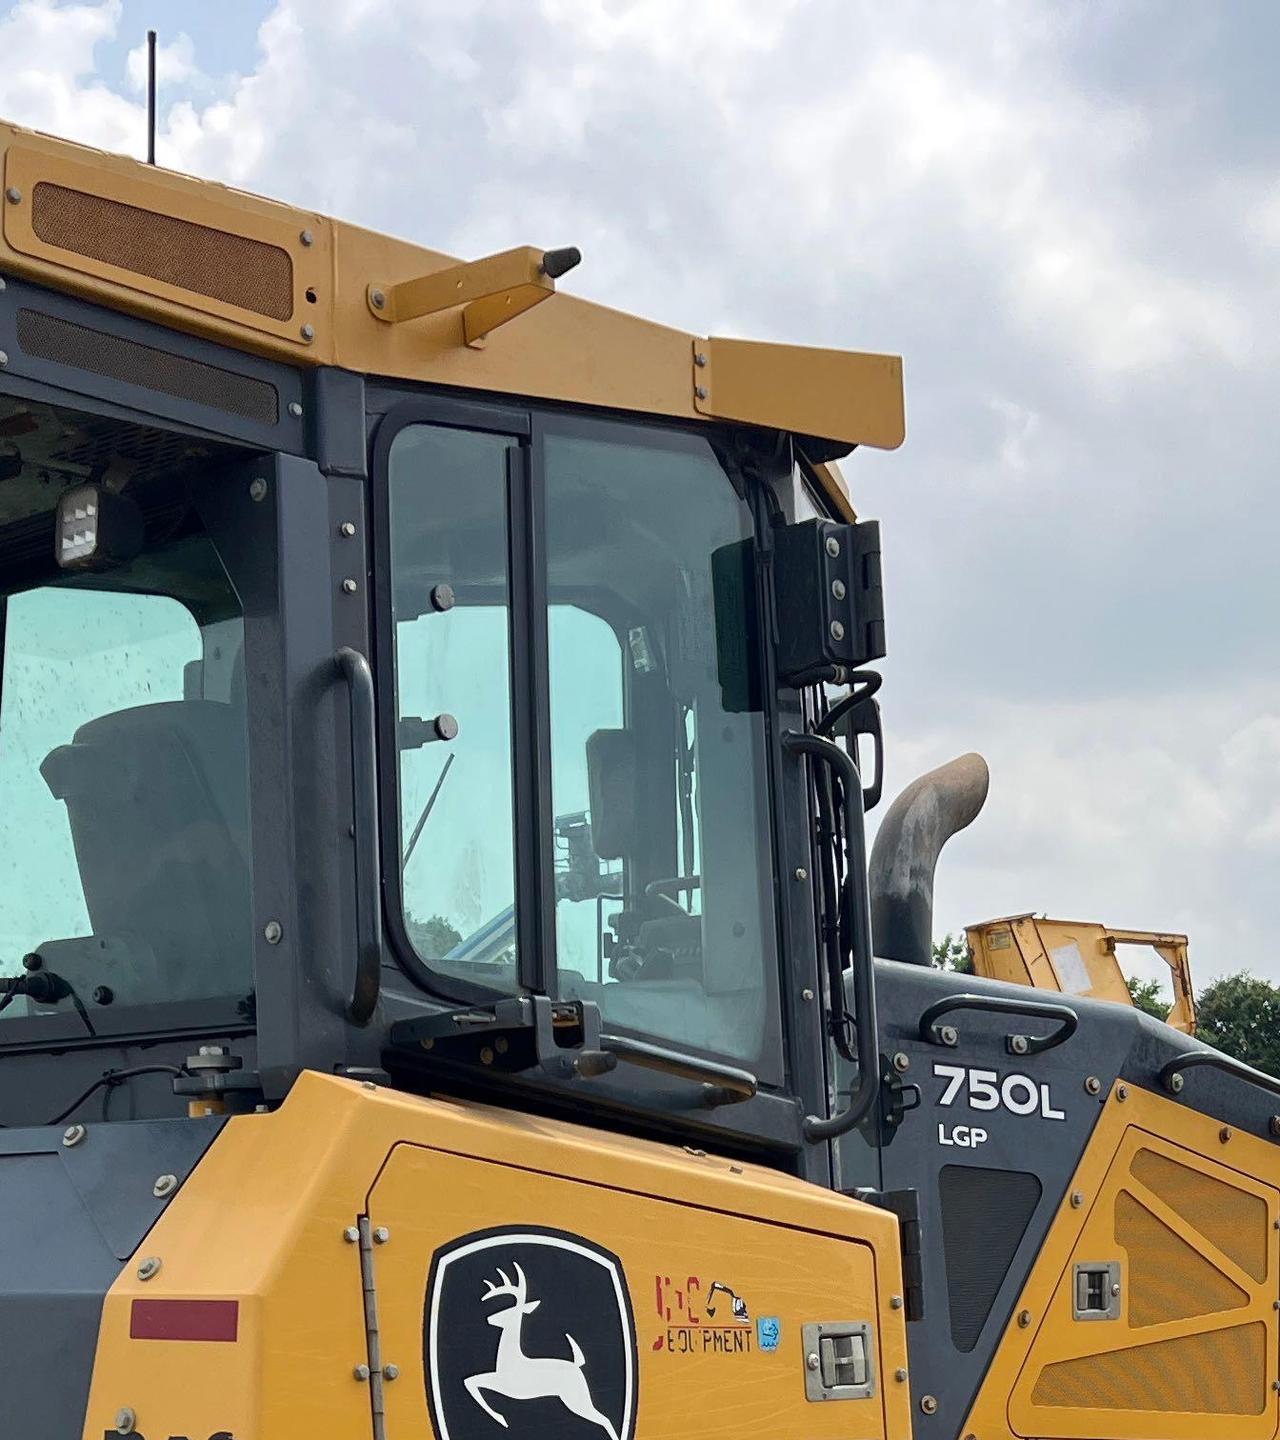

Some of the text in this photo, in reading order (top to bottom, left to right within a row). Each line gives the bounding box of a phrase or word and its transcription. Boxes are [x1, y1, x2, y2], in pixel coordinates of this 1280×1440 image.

[933, 1064, 1066, 1120] 750L
[938, 1123, 988, 1149] LGP
[666, 1329, 753, 1353] EQUPMENT
